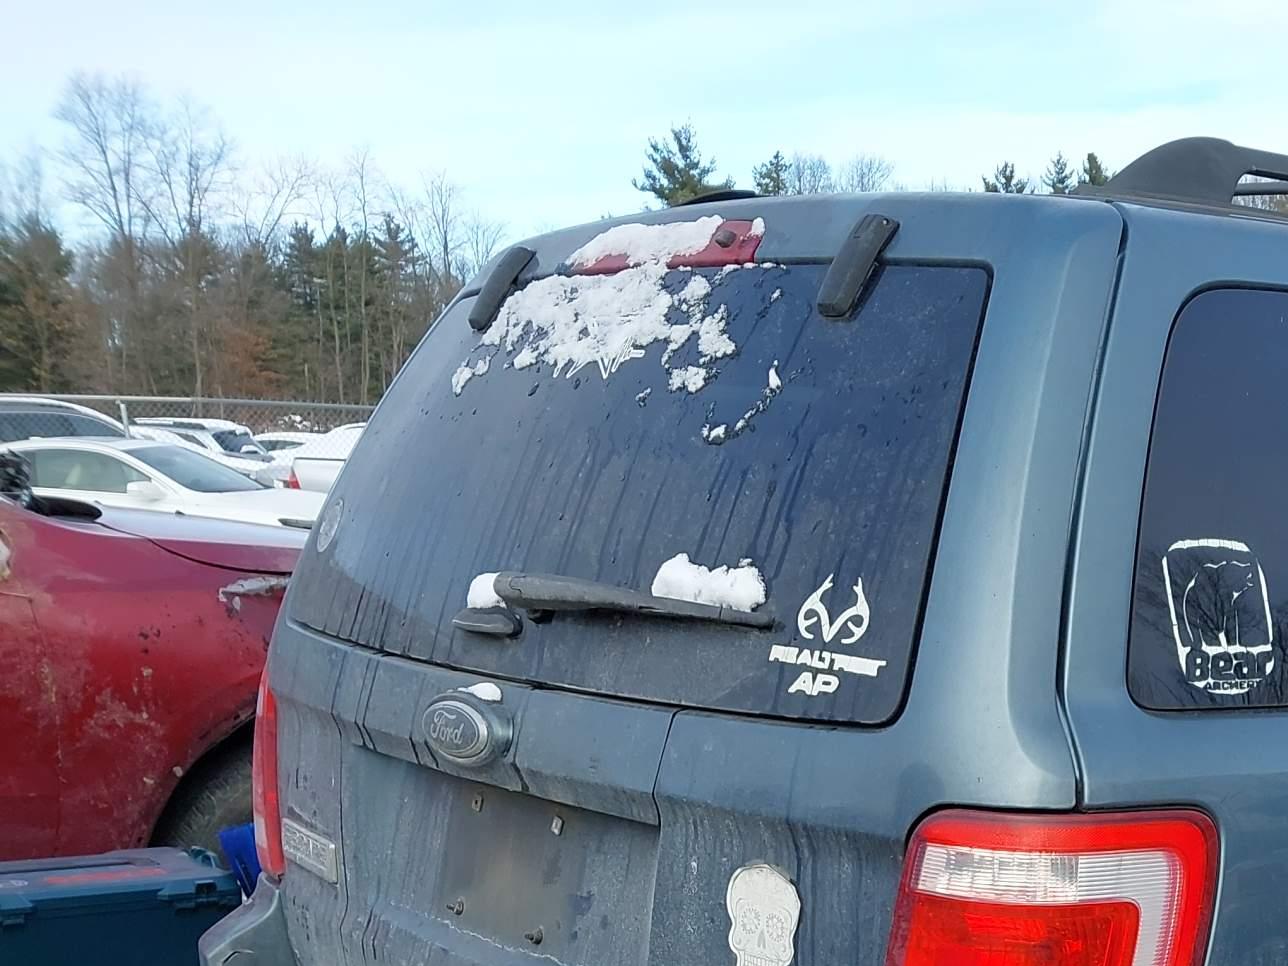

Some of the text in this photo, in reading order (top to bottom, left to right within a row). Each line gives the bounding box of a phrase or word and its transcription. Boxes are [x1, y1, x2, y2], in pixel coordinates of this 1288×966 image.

[1185, 649, 1274, 682] Bear
[787, 671, 840, 696] AP
[430, 709, 465, 744] Ford
